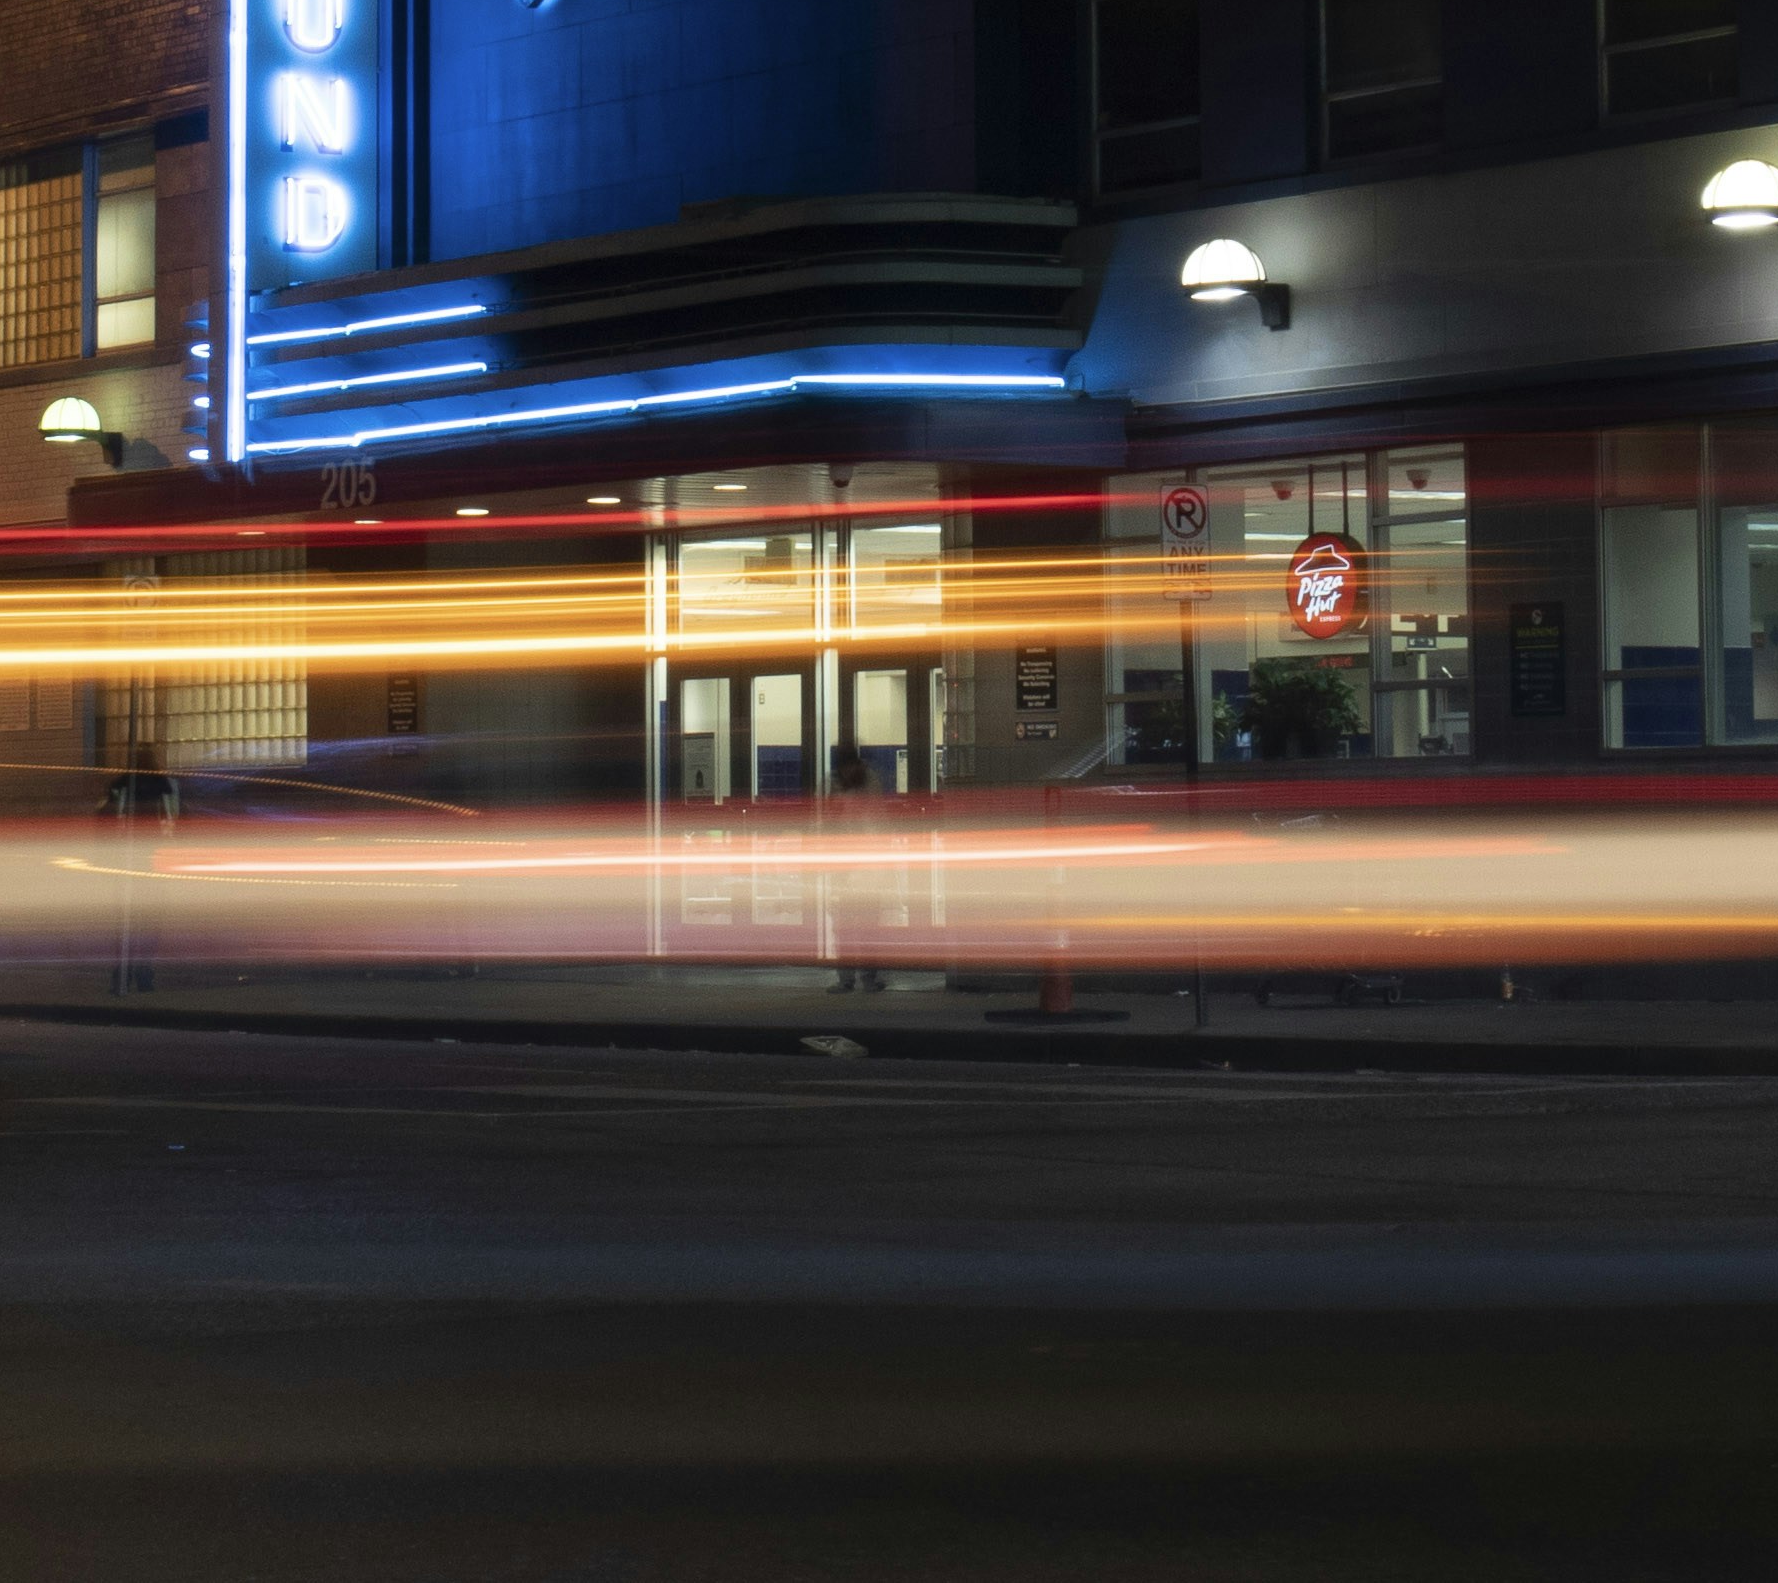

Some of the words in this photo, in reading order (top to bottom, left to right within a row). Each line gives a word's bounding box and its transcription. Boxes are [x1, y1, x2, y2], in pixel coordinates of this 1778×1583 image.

[320, 457, 377, 509] 205
[1169, 545, 1206, 559] ANY
[1167, 562, 1207, 577] TIME
[1296, 572, 1344, 606] Pizza
[1305, 591, 1342, 622] Hut
